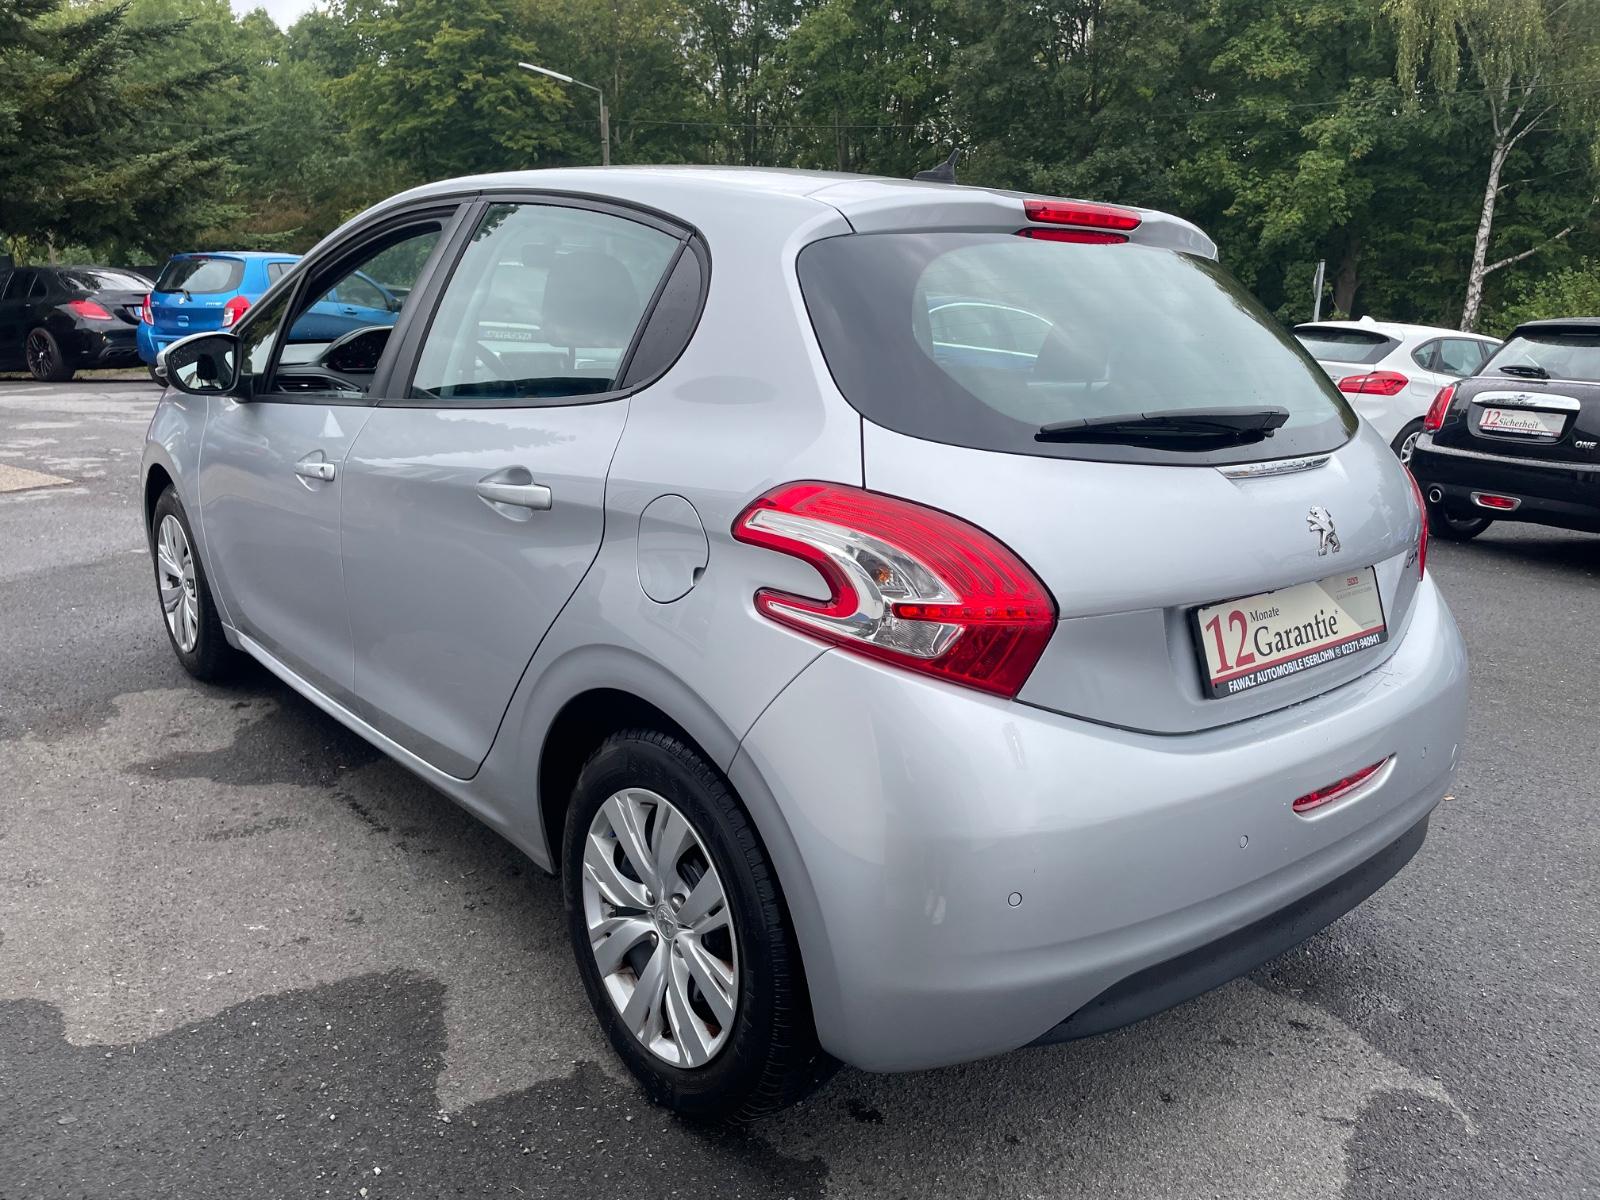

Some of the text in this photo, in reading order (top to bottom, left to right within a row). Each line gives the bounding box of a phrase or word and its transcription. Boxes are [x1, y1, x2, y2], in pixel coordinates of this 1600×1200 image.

[1483, 410, 1538, 429] 12 Sicherheit
[1575, 440, 1598, 449] ONE
[1249, 607, 1280, 623] Monate
[1205, 610, 1256, 674] 12
[1228, 633, 1380, 693] FAWAZ AUTOMOBILE ISERLOHN 02371-940941
